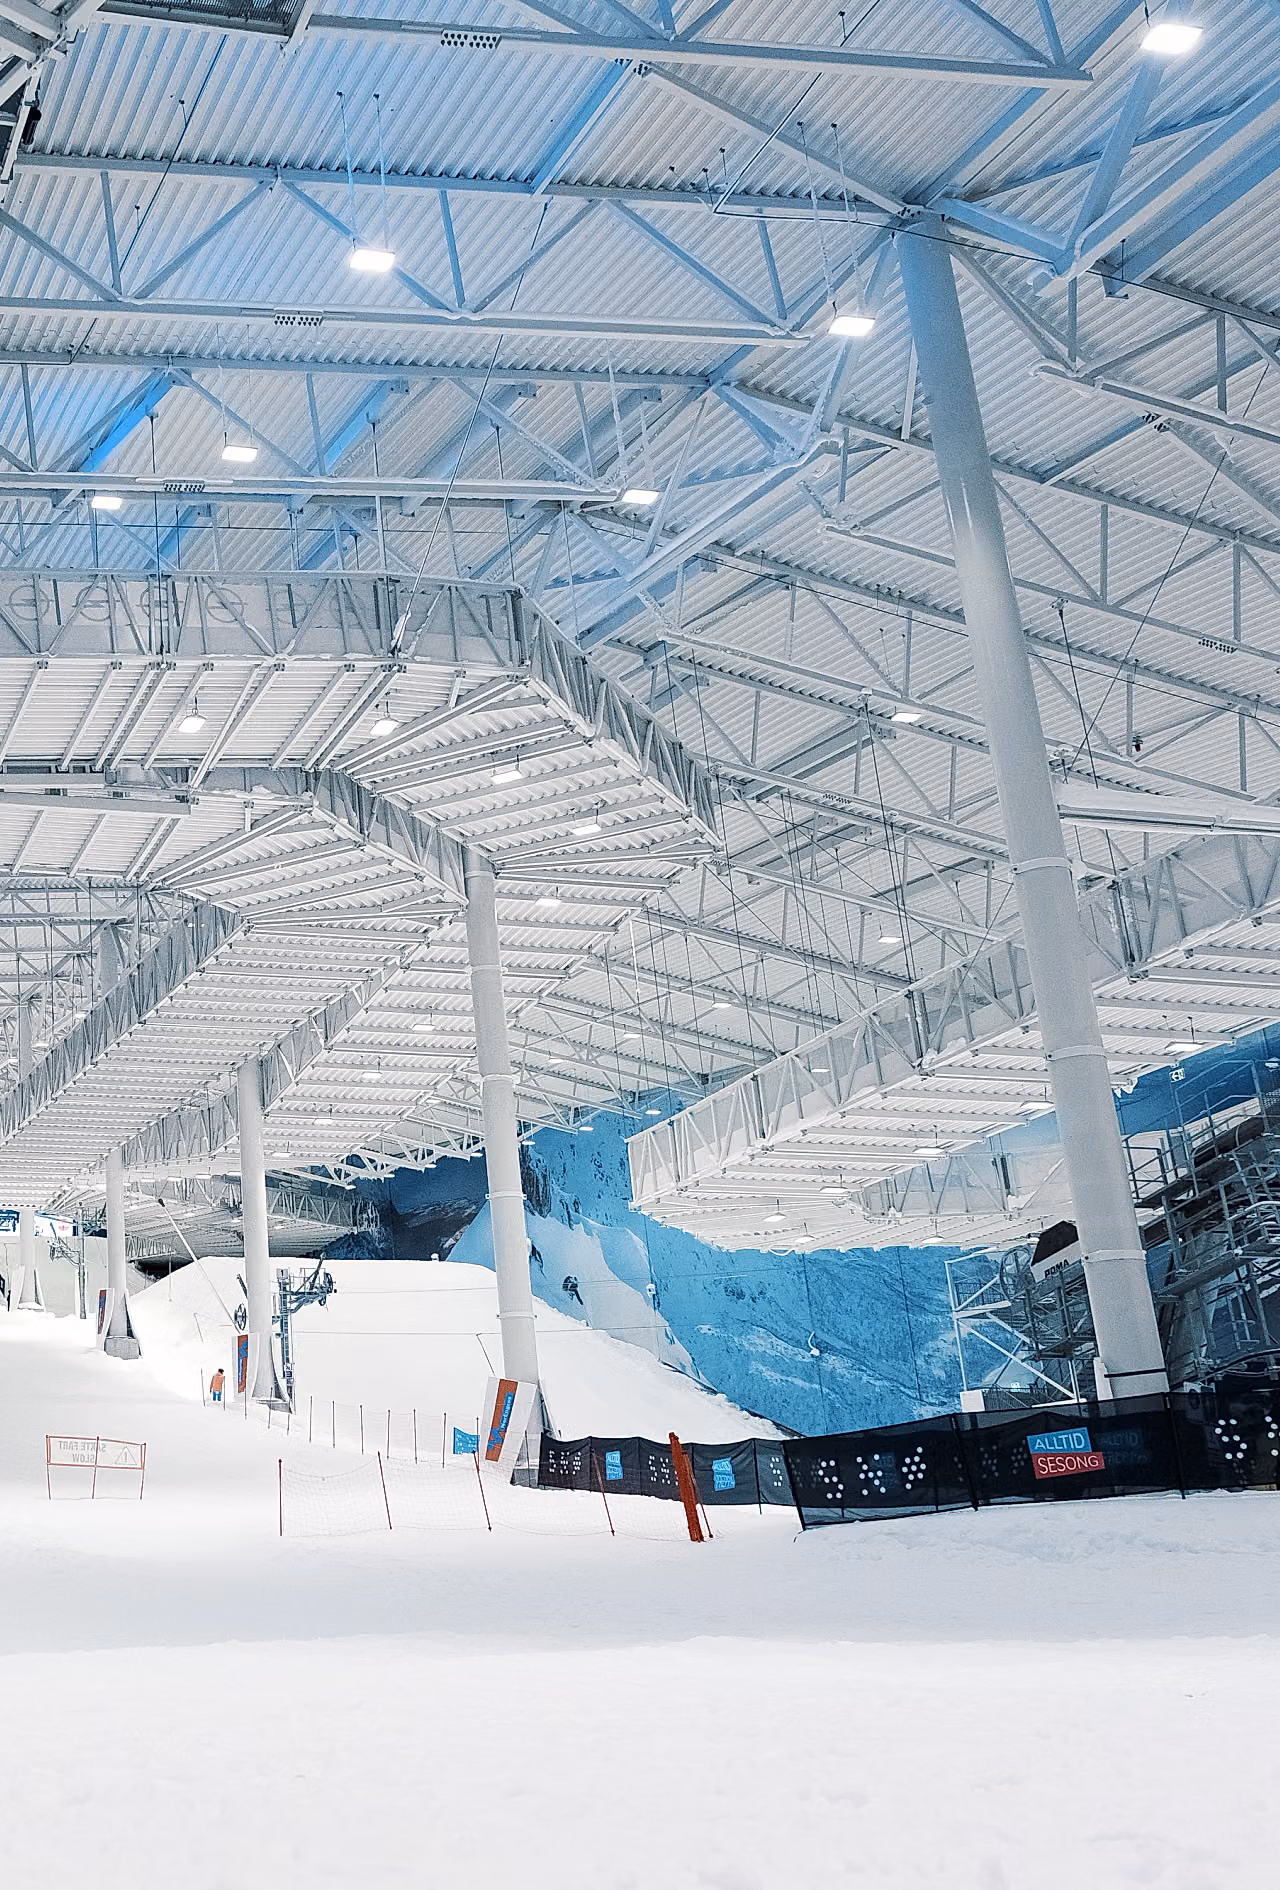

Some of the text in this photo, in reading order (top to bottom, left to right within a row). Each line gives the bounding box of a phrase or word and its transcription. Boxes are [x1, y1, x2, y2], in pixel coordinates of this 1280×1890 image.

[1044, 1259, 1070, 1278] POMA
[1034, 1432, 1085, 1450] ALLTID
[1037, 1455, 1099, 1475] SESONG
